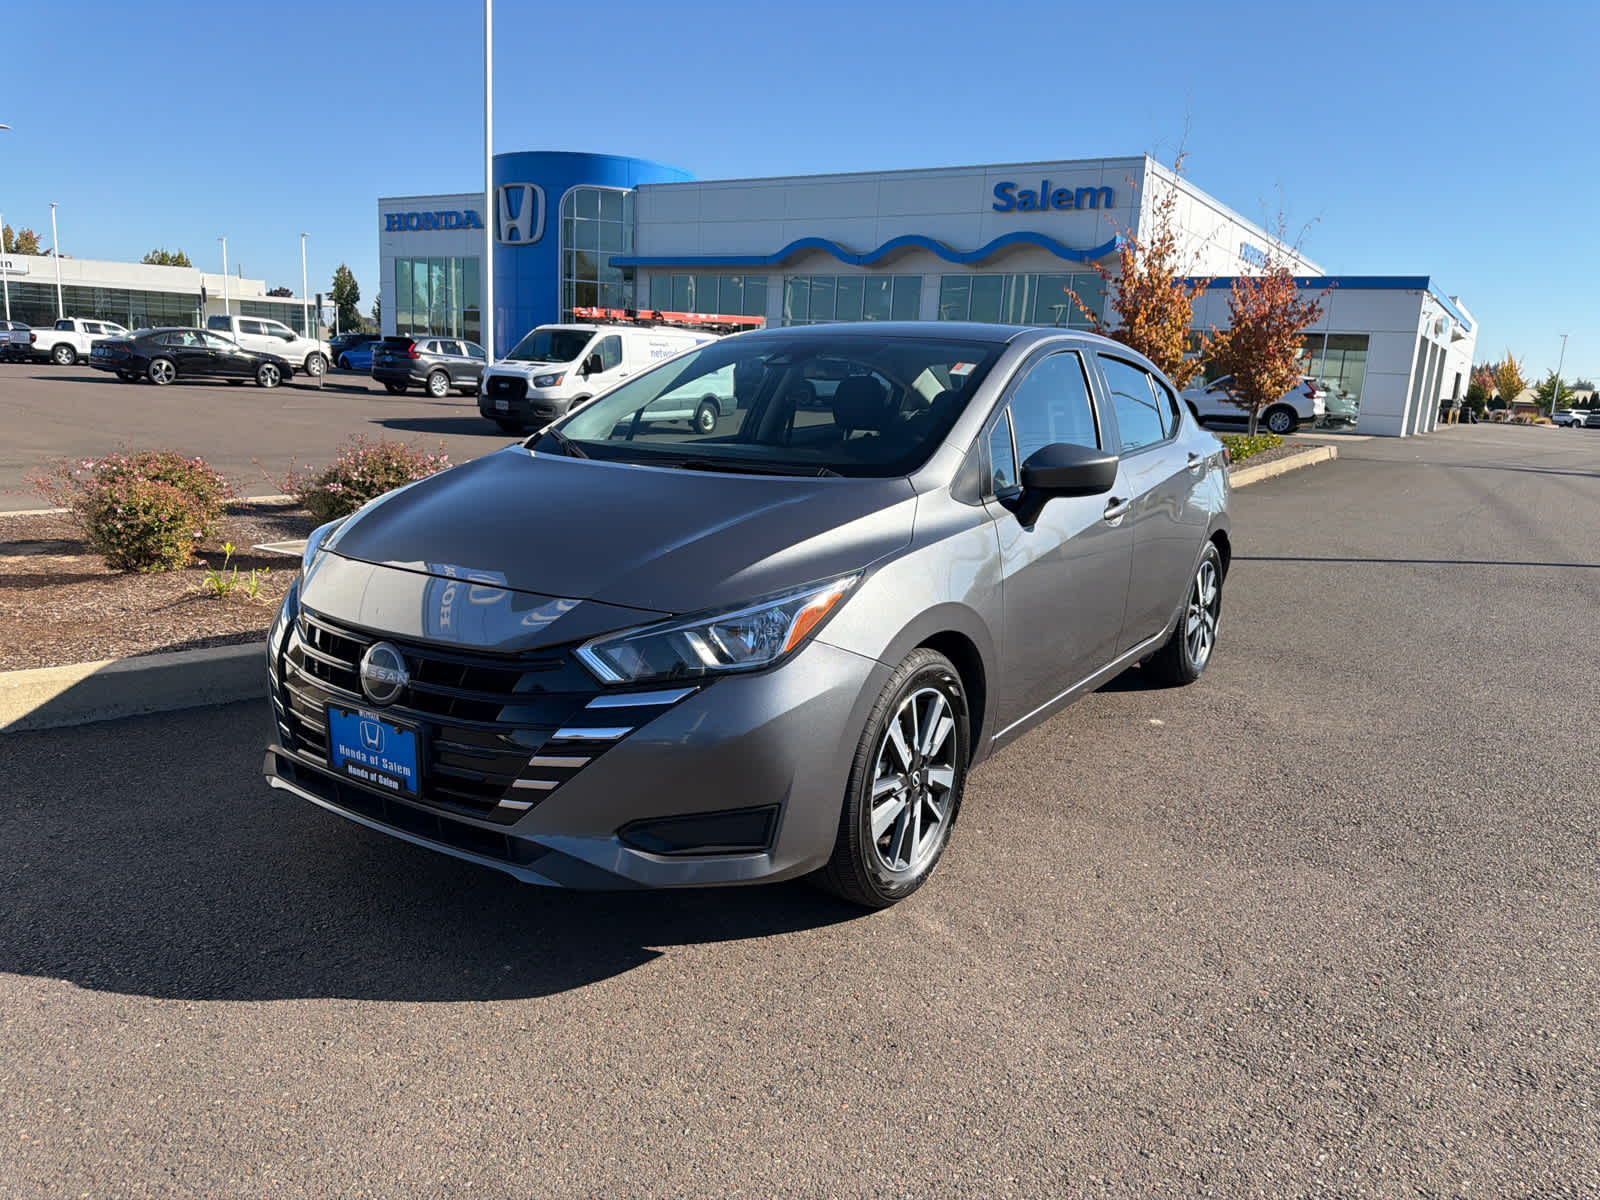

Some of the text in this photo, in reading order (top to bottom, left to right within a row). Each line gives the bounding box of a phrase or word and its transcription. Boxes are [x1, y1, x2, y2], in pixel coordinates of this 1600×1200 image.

[992, 179, 1114, 212] Salem
[383, 209, 485, 232] HONDA
[339, 743, 411, 777] Honda of Salem
[347, 764, 369, 779] Honda
[378, 774, 399, 790] Salem
